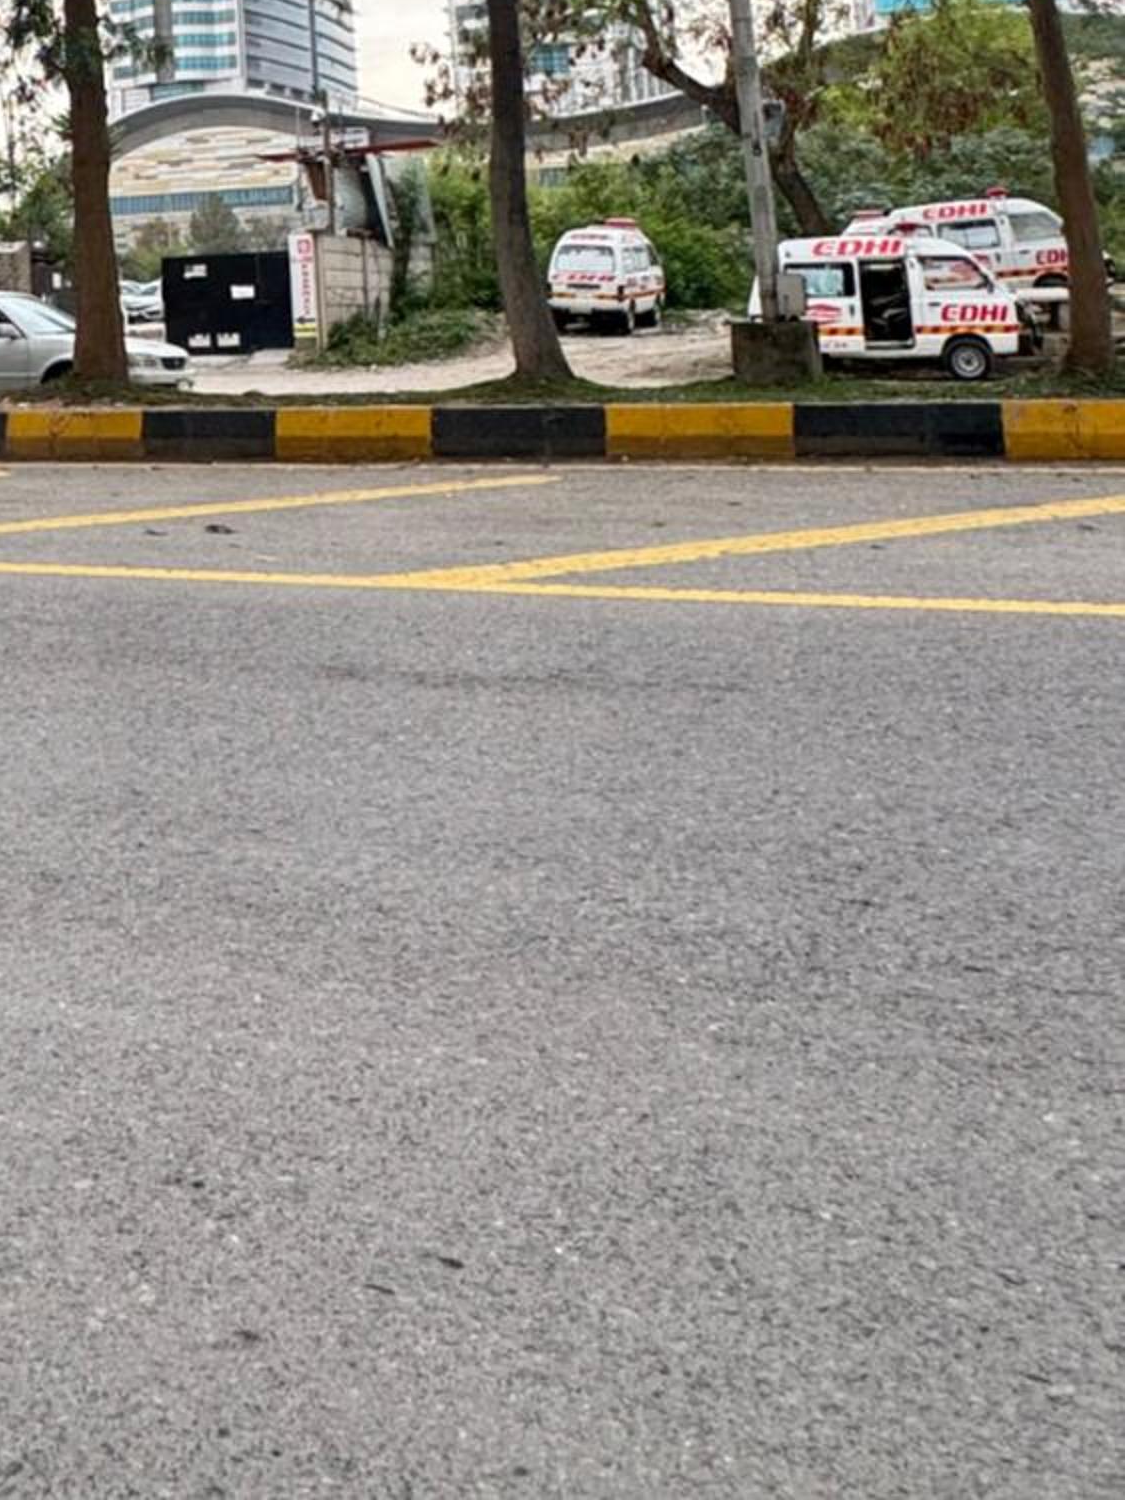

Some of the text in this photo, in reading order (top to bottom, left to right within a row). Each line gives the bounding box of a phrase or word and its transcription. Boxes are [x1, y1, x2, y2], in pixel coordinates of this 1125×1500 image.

[923, 203, 988, 220] EDHI
[813, 240, 902, 256] EDHI
[1035, 250, 1068, 265] EDH
[940, 304, 1008, 322] EDHI
